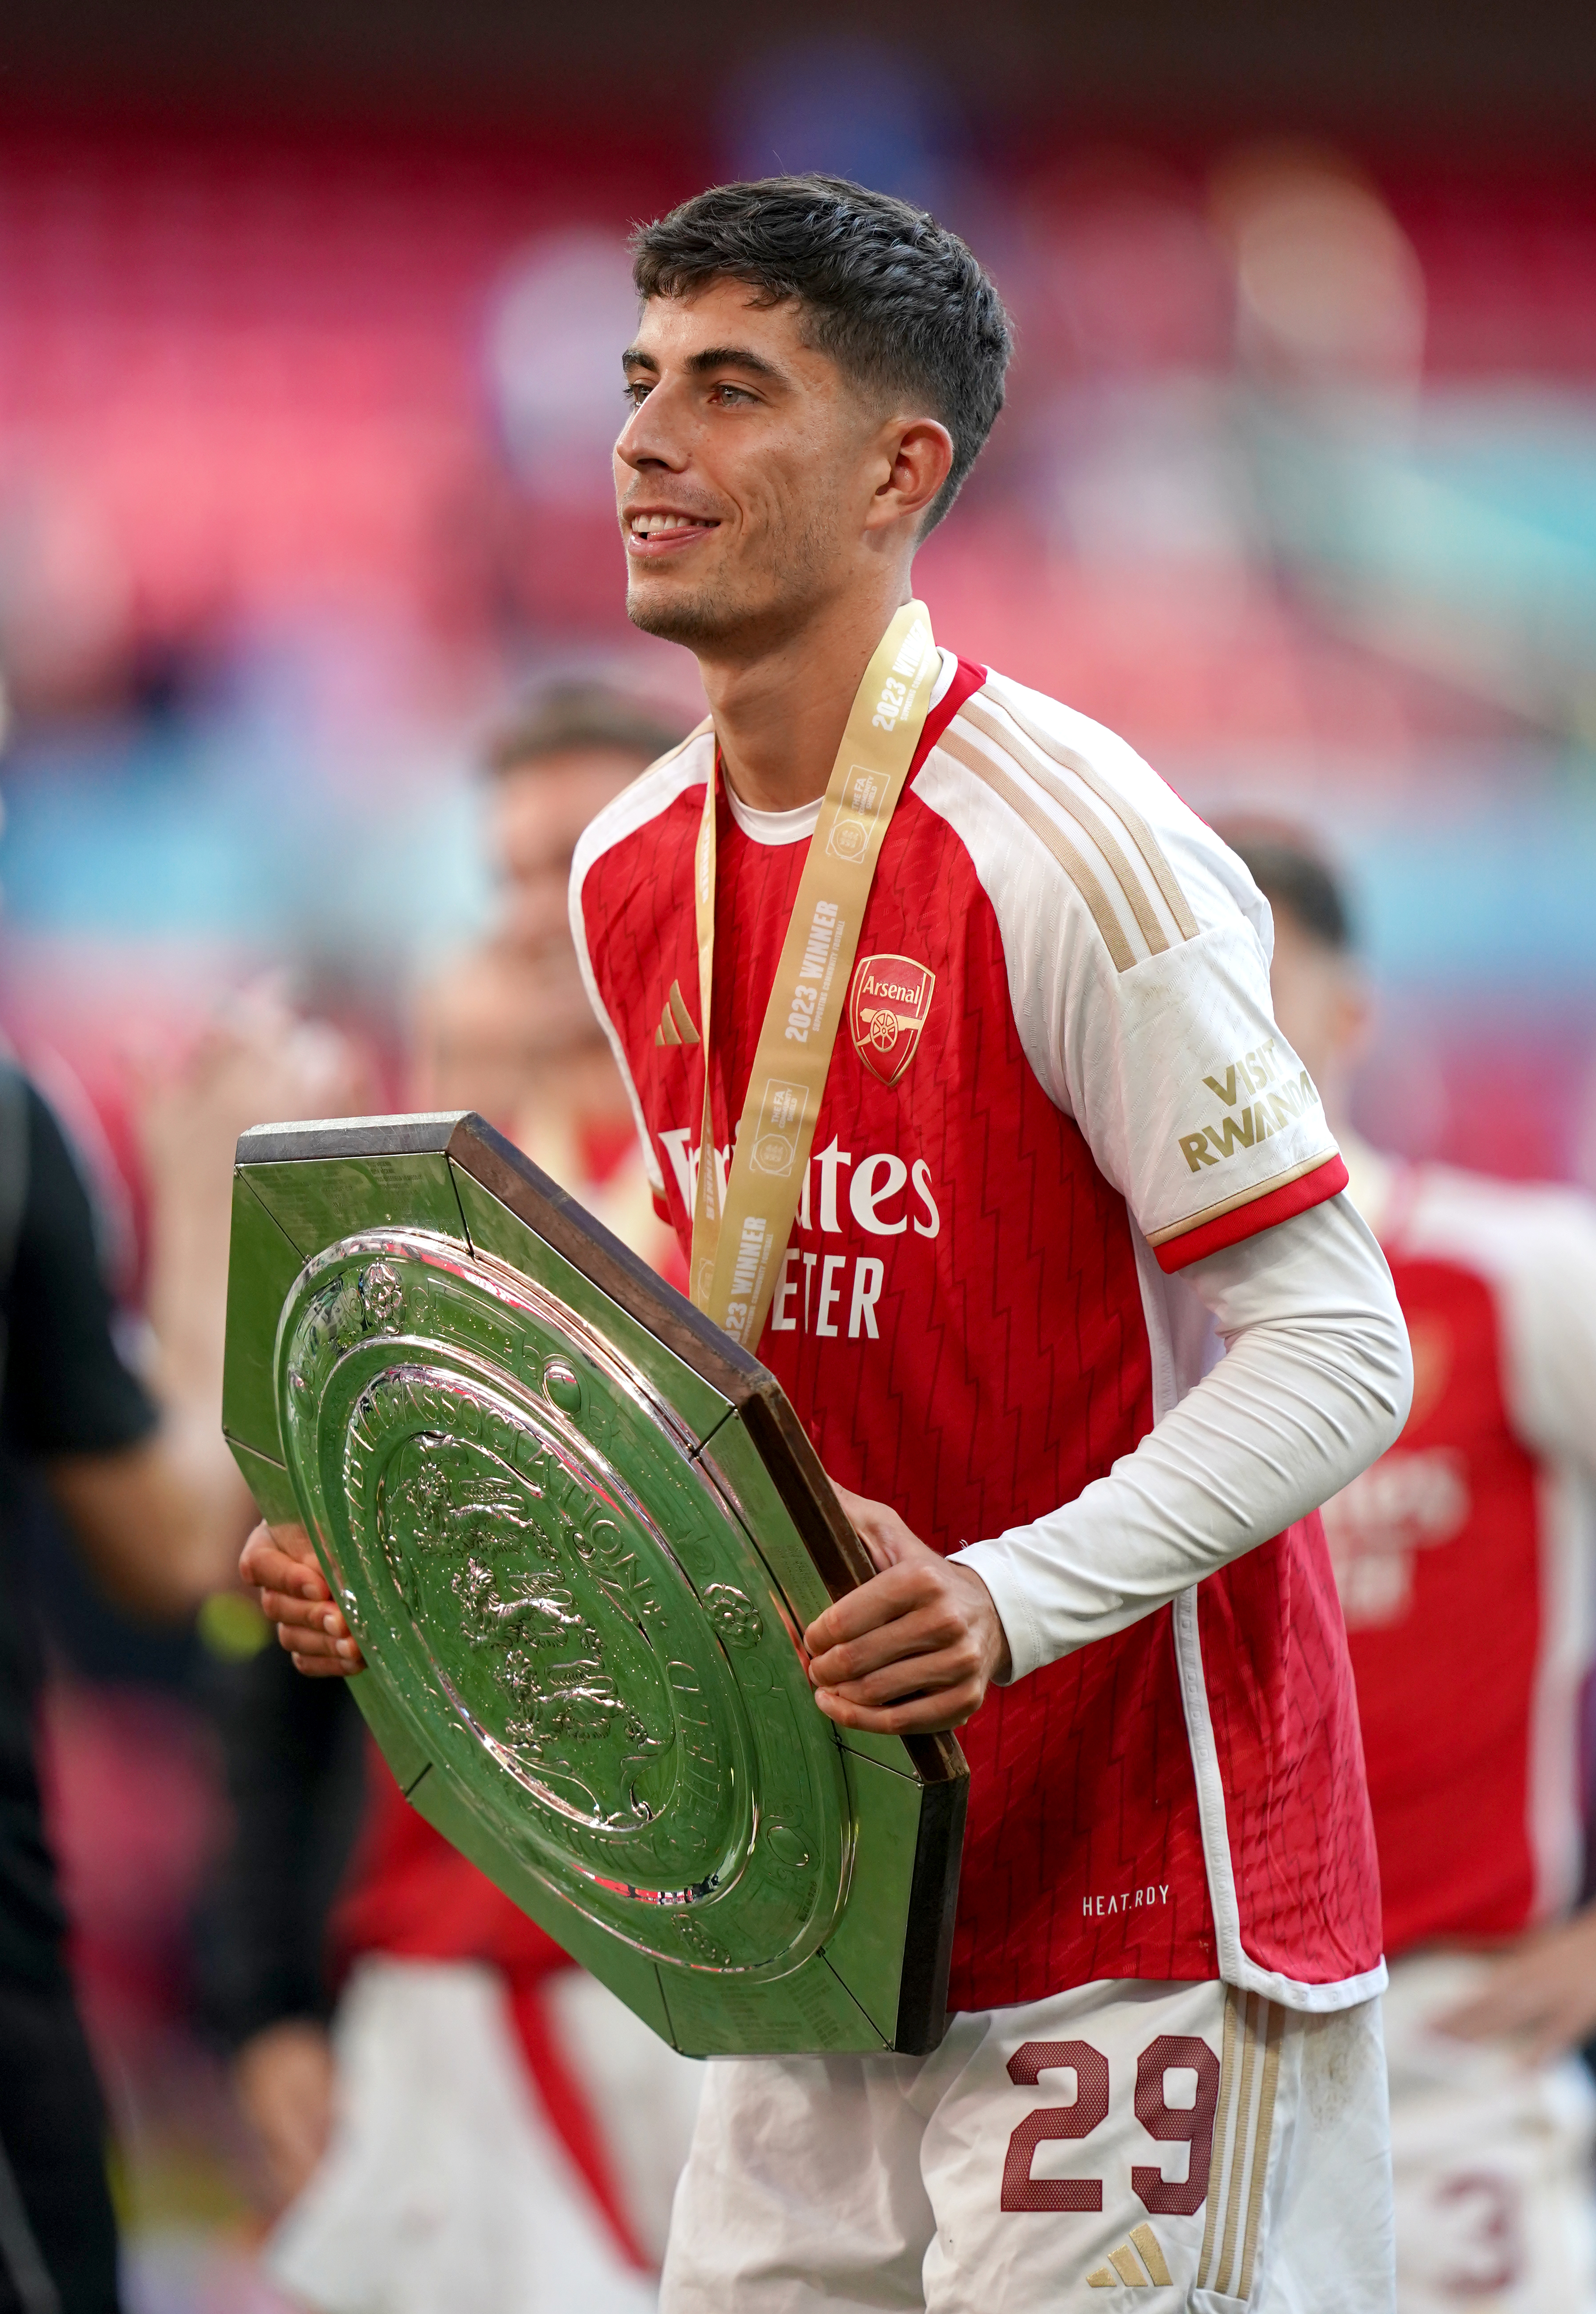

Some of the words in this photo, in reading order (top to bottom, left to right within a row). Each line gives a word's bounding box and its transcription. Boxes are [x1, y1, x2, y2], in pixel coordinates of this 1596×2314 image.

[871, 677, 904, 731] 2023
[854, 777, 866, 792] FA
[799, 900, 839, 978] WINNER
[822, 951, 838, 990] COMMUNITY
[862, 975, 921, 1004] Arsenal
[785, 985, 818, 1042] 2023
[1202, 1039, 1282, 1107] VISIT
[771, 1106, 782, 1122] THE
[774, 1091, 785, 1105] FA
[1178, 1070, 1319, 1173] RWANDA
[731, 1216, 766, 1294] WINNER
[725, 1302, 747, 1342] 023
[1083, 1885, 1169, 1916] HEAT.RDY
[1001, 2035, 1220, 2216] 29
